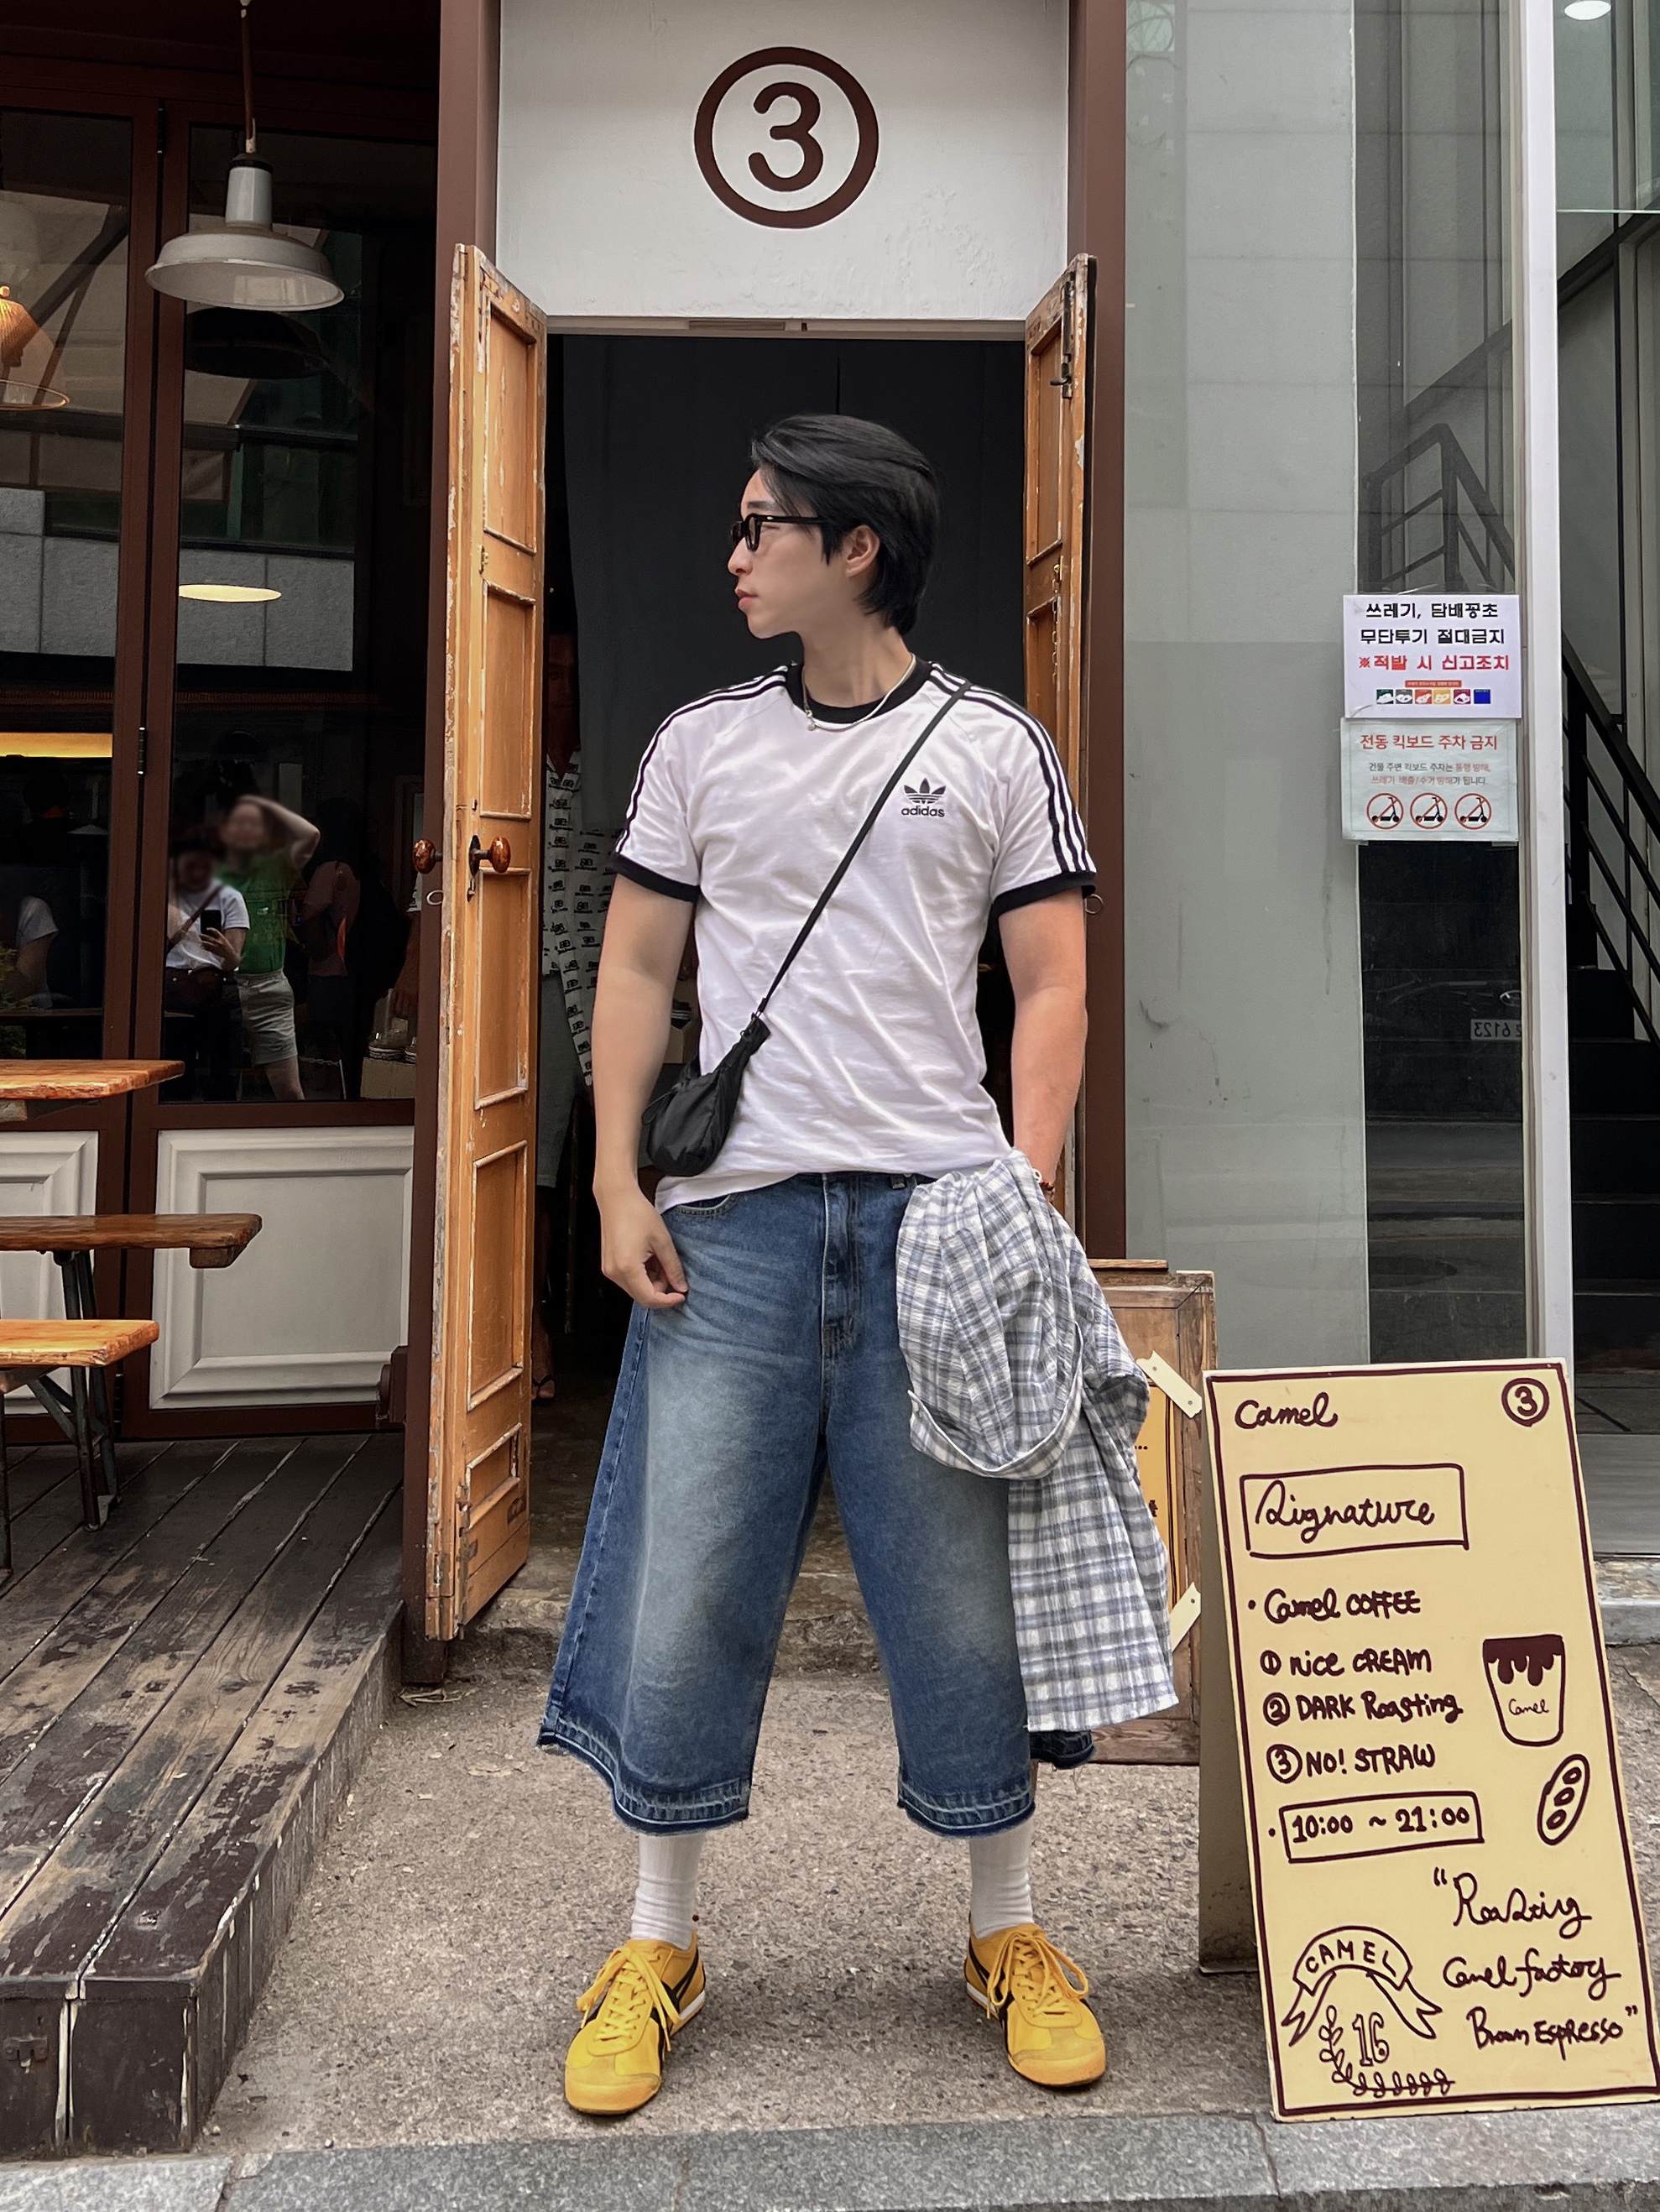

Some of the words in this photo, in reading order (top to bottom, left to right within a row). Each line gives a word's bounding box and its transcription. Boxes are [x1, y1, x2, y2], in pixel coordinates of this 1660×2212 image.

[748, 81, 824, 193] 3
[1366, 603, 1422, 619] 쓰레기,
[1431, 603, 1498, 619] 담배꽁초
[1360, 629, 1428, 644] 무단투기
[1438, 629, 1505, 644] 절대금지
[1417, 655, 1432, 670] 시
[1442, 655, 1509, 670] 신고조치
[1360, 735, 1388, 750] 전동
[1393, 735, 1434, 749] 킥보드
[1438, 735, 1465, 750] 주차
[1470, 735, 1497, 750] 금지
[1369, 763, 1384, 772] 건물
[1386, 763, 1402, 772] 주변
[1405, 763, 1428, 772] 킥보드
[1430, 763, 1453, 773] 주차는
[1455, 763, 1471, 773] 통행
[1371, 776, 1396, 785] 쓰레기
[1437, 776, 1460, 785] 방해가
[901, 806, 945, 817] adidas
[1235, 1392, 1339, 1430] Camel
[1514, 1385, 1538, 1417] 3
[1255, 1480, 1435, 1543] Signature
[1264, 1587, 1341, 1625] Camel
[1345, 1589, 1421, 1620] COFFEE
[1295, 1693, 1356, 1722] DARK
[1360, 1690, 1464, 1724] Roasting
[1508, 1698, 1550, 1716] Camel
[1305, 1748, 1348, 1778] NO!
[1355, 1743, 1436, 1776] STRAW
[1292, 1814, 1354, 1844] 10:00
[1395, 1805, 1470, 1833] 21:00
[1305, 1938, 1396, 1978] CAMEL
[1442, 1955, 1518, 1990] Camel
[1352, 2011, 1390, 2068] 16
[1465, 2006, 1530, 2050] Brown
